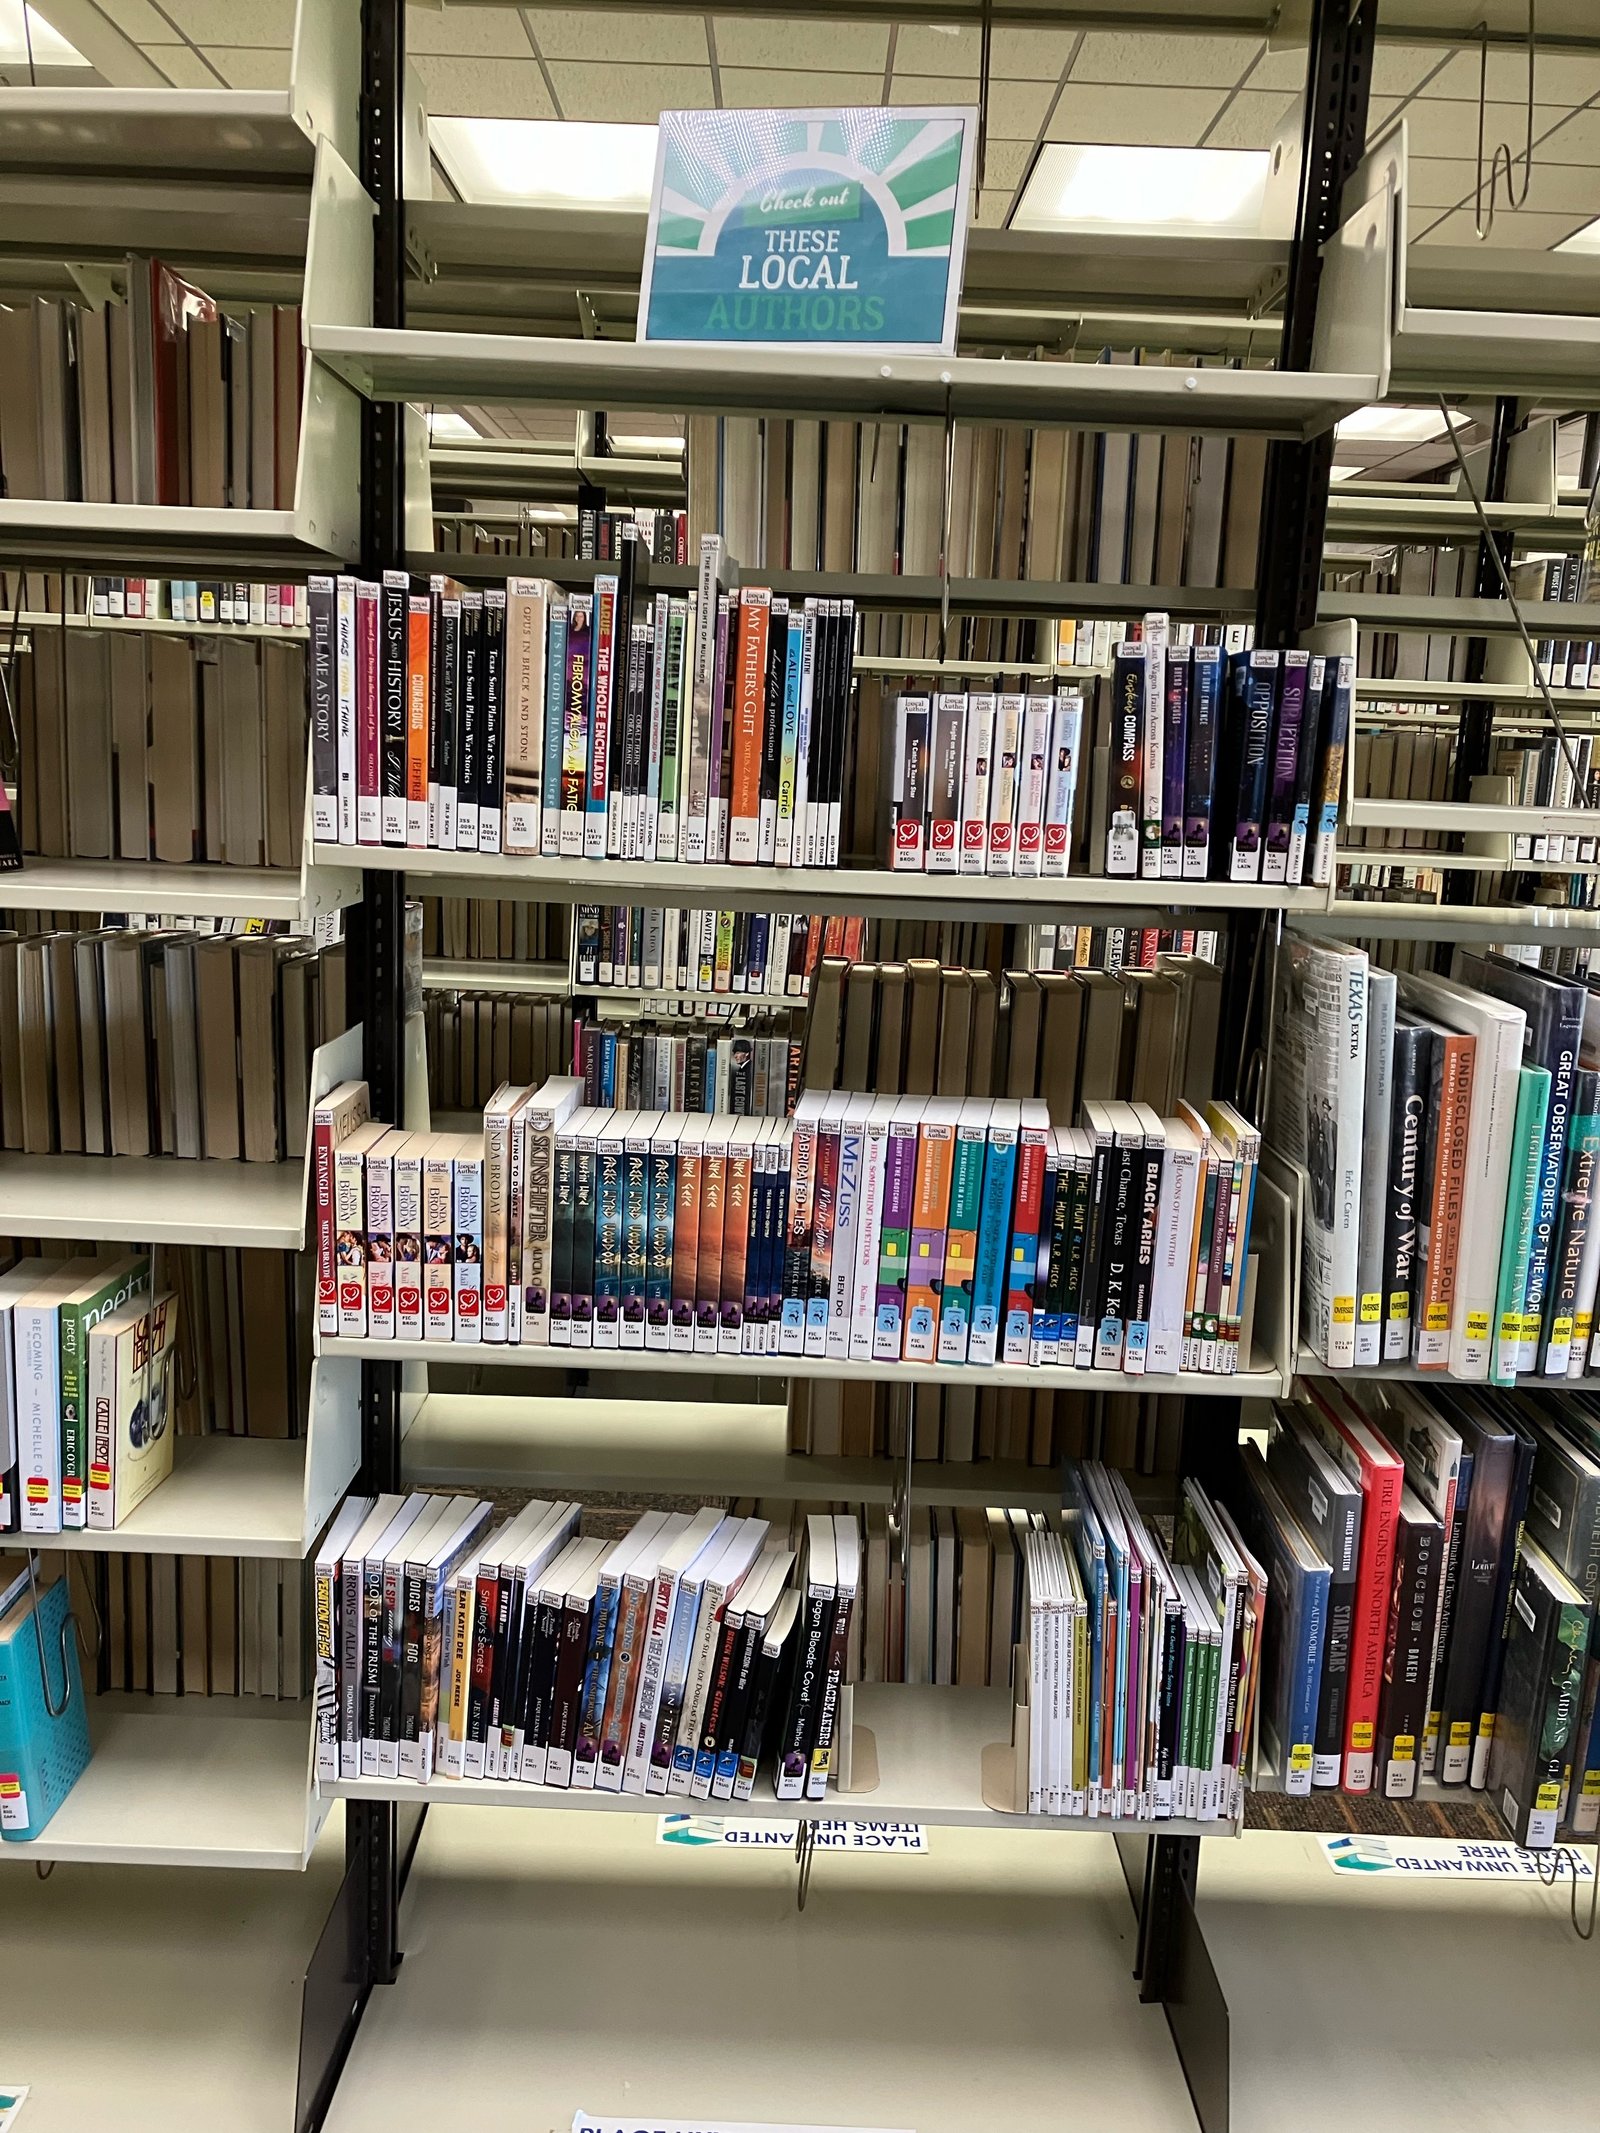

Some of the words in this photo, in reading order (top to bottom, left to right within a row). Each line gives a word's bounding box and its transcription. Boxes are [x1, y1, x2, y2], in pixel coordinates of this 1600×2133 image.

[759, 186, 817, 213] Check
[819, 187, 849, 207] out
[764, 230, 840, 252] THESE
[738, 255, 859, 290] LOCAL
[703, 294, 885, 331] AUTHORS
[703, 556, 711, 569] THE
[702, 572, 710, 600] BRIGHT
[386, 589, 402, 640] JESUS
[522, 606, 531, 635] OPUS
[600, 597, 611, 635] LARUE
[701, 603, 709, 629] LIGHTS
[748, 607, 760, 629] MY
[315, 613, 330, 651] TELL
[522, 641, 530, 653] IN
[553, 624, 563, 649] IT'S
[701, 632, 708, 641] OF
[316, 653, 329, 677] ME
[487, 650, 497, 673] Texas
[553, 654, 562, 667] IN
[598, 647, 608, 671] THE
[699, 644, 707, 684] MULESHOE
[744, 635, 759, 696] FATHER'S
[1151, 643, 1160, 660] Last
[316, 680, 328, 691] A
[521, 658, 530, 691] BRICK
[786, 659, 796, 681] ALL
[1149, 662, 1159, 689] Wagon
[386, 659, 402, 731] HISTORY
[411, 674, 424, 729] COURAGEOUS
[487, 676, 497, 702] South
[551, 673, 561, 711] GOD'S
[568, 654, 584, 750] FIBROMYALGIA
[595, 675, 607, 718] WHOLE
[1150, 692, 1159, 712] Train
[317, 693, 330, 743] STORY
[486, 705, 496, 731] Plains
[520, 697, 529, 720] AND
[742, 701, 756, 736] GIFT
[784, 704, 794, 734] LOVE
[1246, 682, 1271, 765] OPPOSITION
[550, 717, 560, 759] HANDS
[766, 709, 776, 761] professional
[1122, 715, 1137, 761] COMPASS
[1149, 714, 1159, 740] Across
[1275, 687, 1301, 780] SUBJECTION
[487, 735, 495, 752] War
[519, 725, 529, 761] STONE
[592, 721, 605, 787] ENCHILADA
[1149, 742, 1158, 770] Kansas
[485, 755, 494, 784] Stories
[781, 781, 790, 813] Carrie
[1346, 970, 1363, 1021] TEXAS
[1380, 1003, 1388, 1045] MARCIA
[603, 1039, 611, 1059] SARAH
[1349, 1023, 1359, 1060] EXTRA
[586, 1046, 595, 1084] MARQUIS
[602, 1061, 611, 1085] VOWELL
[1378, 1049, 1386, 1096] LIPPMAN
[1553, 1051, 1573, 1099] GREAT
[1450, 1052, 1472, 1171] UNDISCLOSED
[869, 1144, 878, 1163] HER
[1393, 1095, 1424, 1199] Century
[1540, 1104, 1566, 1218] OBSERVATORIES
[318, 1146, 329, 1206] ENTANGLED
[512, 1165, 518, 1177] TO
[1343, 1170, 1353, 1187] Eric
[1439, 1150, 1450, 1177] PHILIP
[490, 1164, 501, 1216] BRODAY
[528, 1135, 549, 1242] SKINSHIFTER
[865, 1165, 875, 1215] SOMETHING
[1076, 1174, 1088, 1195] THE
[1115, 1169, 1131, 1212] Chance,
[1143, 1163, 1159, 1213] BLACK
[1343, 1190, 1352, 1199] C.
[1436, 1180, 1448, 1219] MESSING,
[1446, 1176, 1462, 1221] FILES
[339, 1180, 351, 1224] BRODAY
[349, 1187, 359, 1216] LINDA
[1342, 1202, 1352, 1229] Caren
[1395, 1203, 1414, 1223] of
[793, 1209, 807, 1235] LIES
[1073, 1204, 1085, 1232] HUNT
[1112, 1215, 1128, 1246] Texas
[321, 1220, 330, 1251] MELISSA
[862, 1218, 872, 1265] IMPETUOUS
[1139, 1219, 1155, 1265] ARIES
[1538, 1224, 1552, 1244] OF
[529, 1246, 541, 1275] ALYCIA
[791, 1251, 801, 1283] PATRICK
[1071, 1246, 1081, 1262] L.R.
[1395, 1232, 1415, 1280] War
[1531, 1247, 1548, 1277] THE
[1561, 1229, 1586, 1299] Nature
[836, 1275, 845, 1294] BEN
[1068, 1266, 1079, 1291] HICKS
[32, 1318, 42, 1381] BECOMING
[63, 1318, 75, 1355] peety
[32, 1403, 43, 1459] MICHELLE
[95, 1397, 109, 1434] CALLE
[1380, 1479, 1393, 1508] FIRE
[1375, 1512, 1390, 1568] ENGINES
[1448, 1522, 1462, 1571] Landmarks
[1374, 1571, 1386, 1584] IN
[1447, 1573, 1455, 1581] of
[477, 1589, 489, 1633] Shipley's
[1236, 1592, 1244, 1608] Kerry
[1443, 1584, 1454, 1608] Texas
[369, 1609, 377, 1623] OF
[456, 1612, 466, 1639] KATIE
[1369, 1588, 1384, 1637] NORTH
[369, 1626, 378, 1646] THE
[805, 1631, 821, 1669] Bloode:
[1307, 1606, 1319, 1664] AUTOMOBILE
[1436, 1611, 1450, 1663] Architecture
[345, 1633, 356, 1670] ALLAH
[368, 1649, 378, 1684] PRISM
[407, 1643, 418, 1663] FOG
[456, 1642, 464, 1660] DEE
[475, 1636, 487, 1673] Secrets
[1405, 1649, 1419, 1683] BAKERY
[1231, 1662, 1239, 1675] The
[1361, 1640, 1379, 1698] AMERICA
[800, 1671, 814, 1702] Covet
[1229, 1677, 1238, 1696] Lying,
[818, 1669, 840, 1746] PEACEMAKERS
[1227, 1698, 1236, 1716] Lying
[1553, 1680, 1572, 1743] GARDENS
[792, 1718, 805, 1747] Mishka
[853, 1834, 920, 1847] PLACE
[1456, 1845, 1507, 1857] HERE
[1395, 1857, 1515, 1873] UNWANTED
